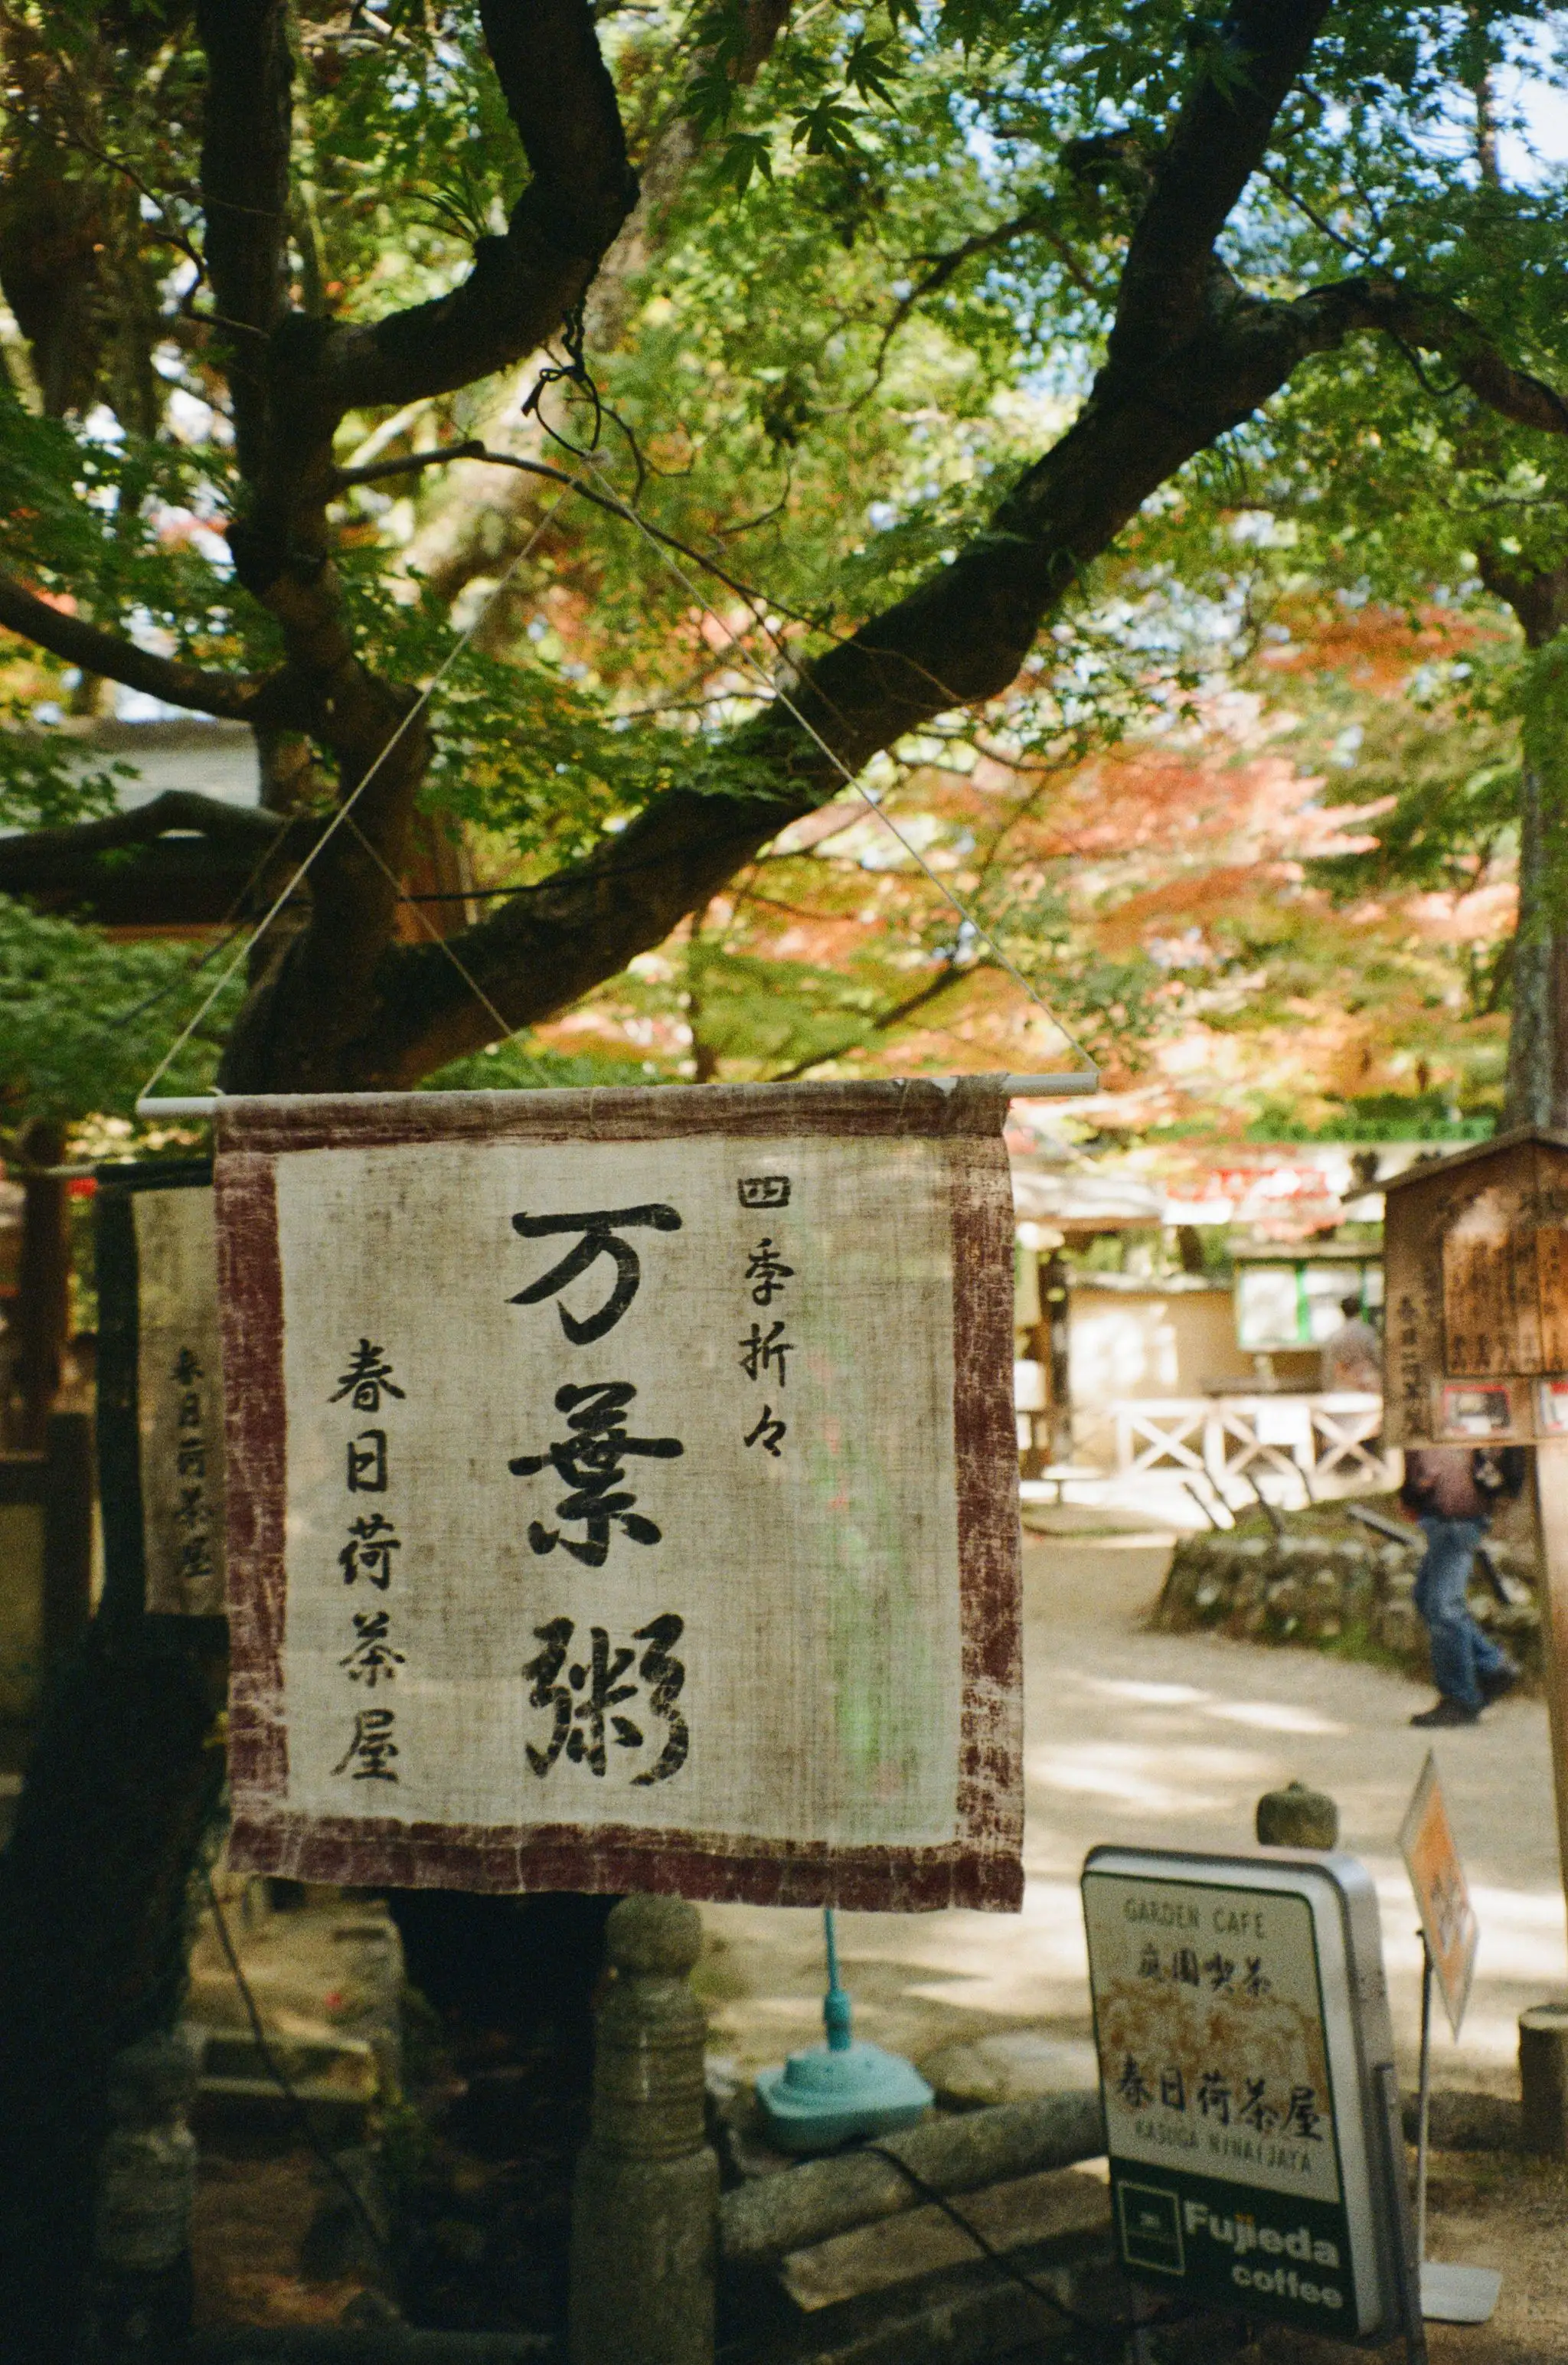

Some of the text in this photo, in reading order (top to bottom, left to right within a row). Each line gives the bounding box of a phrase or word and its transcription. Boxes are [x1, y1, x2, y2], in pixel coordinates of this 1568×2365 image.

[736, 1174, 795, 1458] 四季折々
[505, 1203, 690, 1787] 万葉粥
[328, 1338, 407, 1785] 春日荷茶屋
[1124, 1897, 1266, 1939] GARDEN CAFE
[1116, 2053, 1323, 2141] 春日荷茶屋
[1184, 2199, 1340, 2269] Fujieda
[1231, 2263, 1344, 2310] coffee
